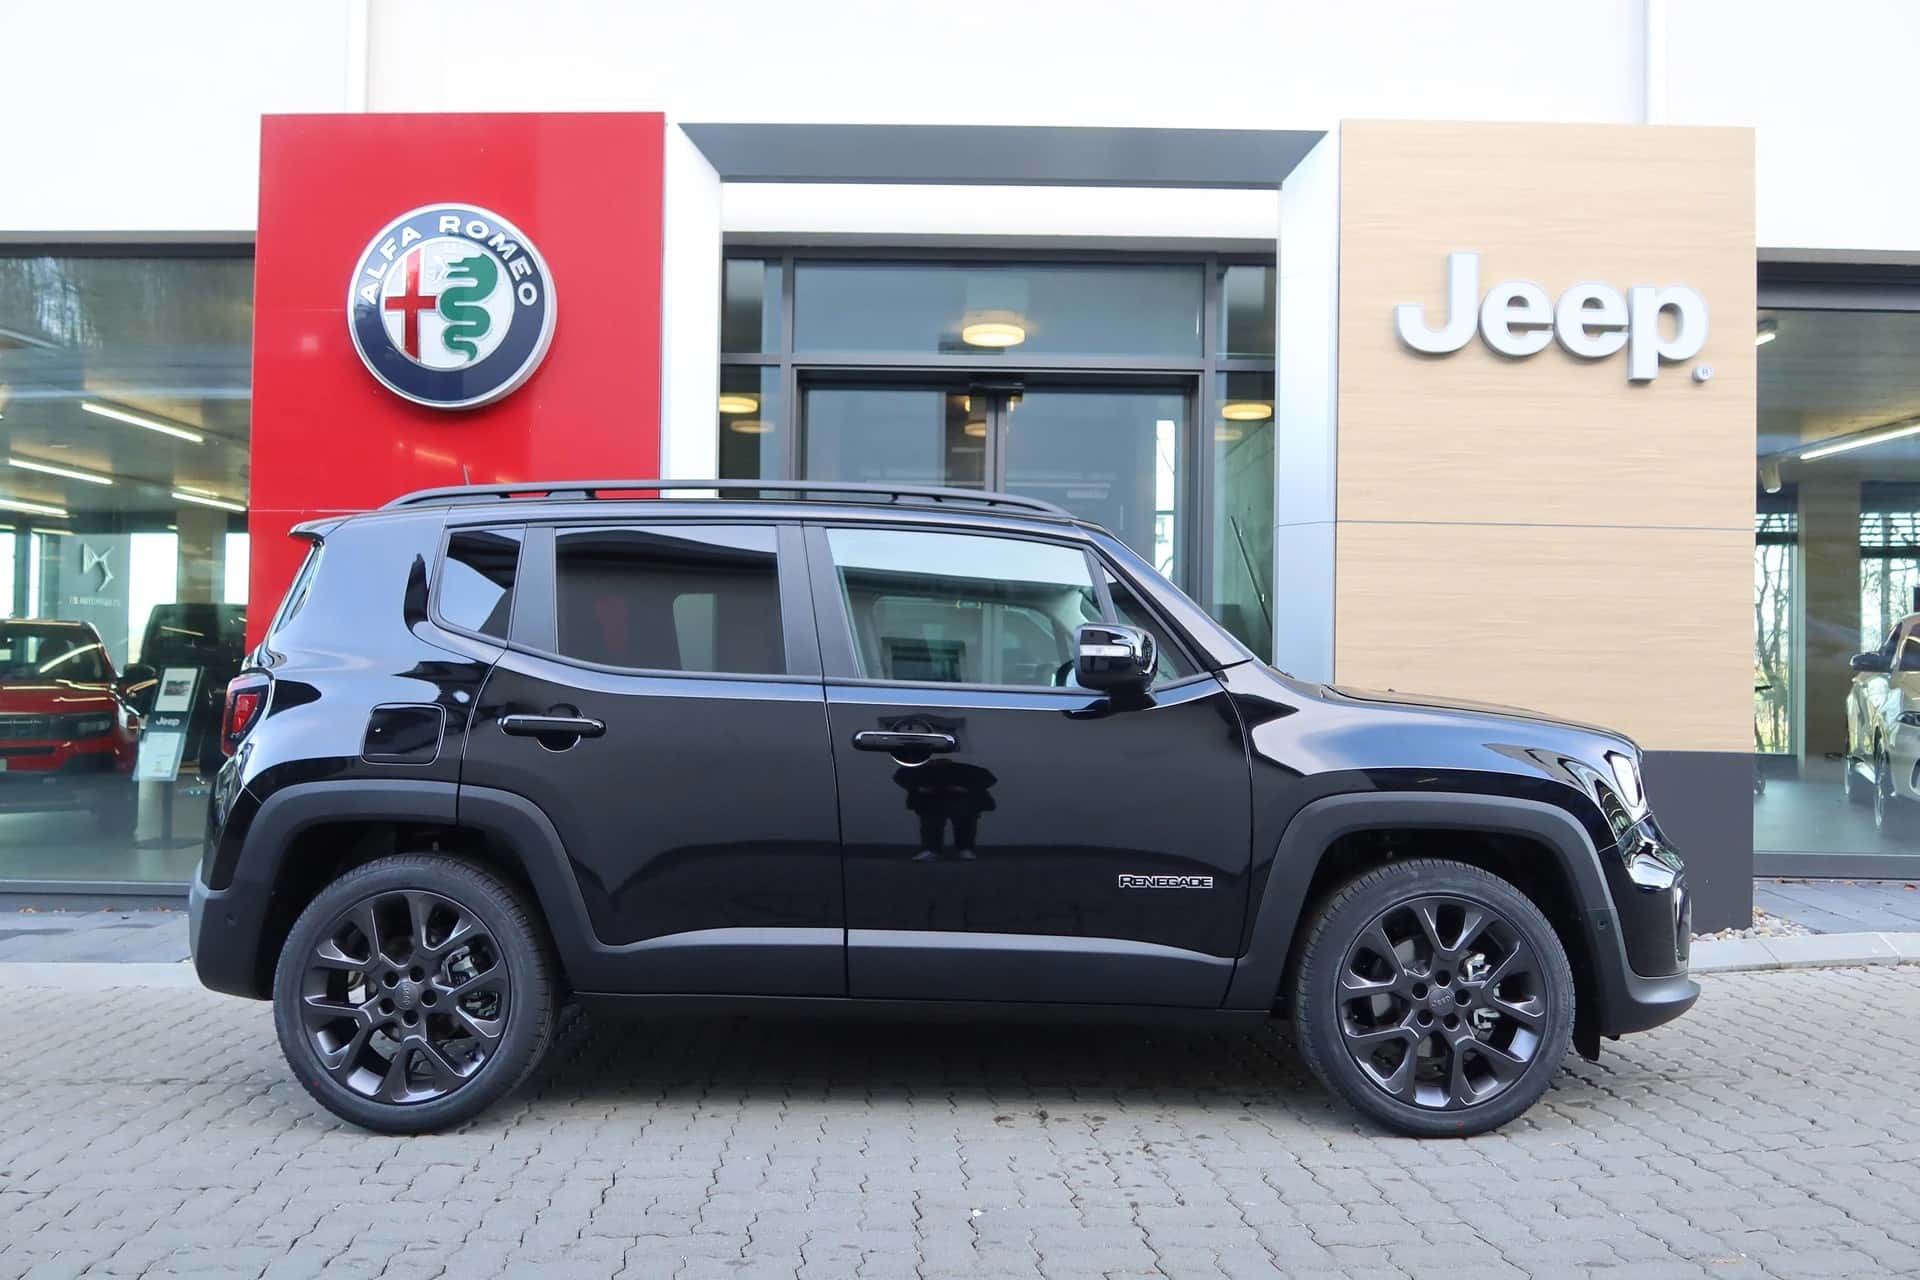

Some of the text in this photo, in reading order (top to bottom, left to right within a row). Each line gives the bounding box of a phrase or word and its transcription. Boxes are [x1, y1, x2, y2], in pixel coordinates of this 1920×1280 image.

[361, 215, 538, 306] ALFA ROMEO
[1396, 250, 1709, 380] Jeep
[155, 716, 180, 727] Jeep
[1118, 873, 1214, 889] RENEGADE
